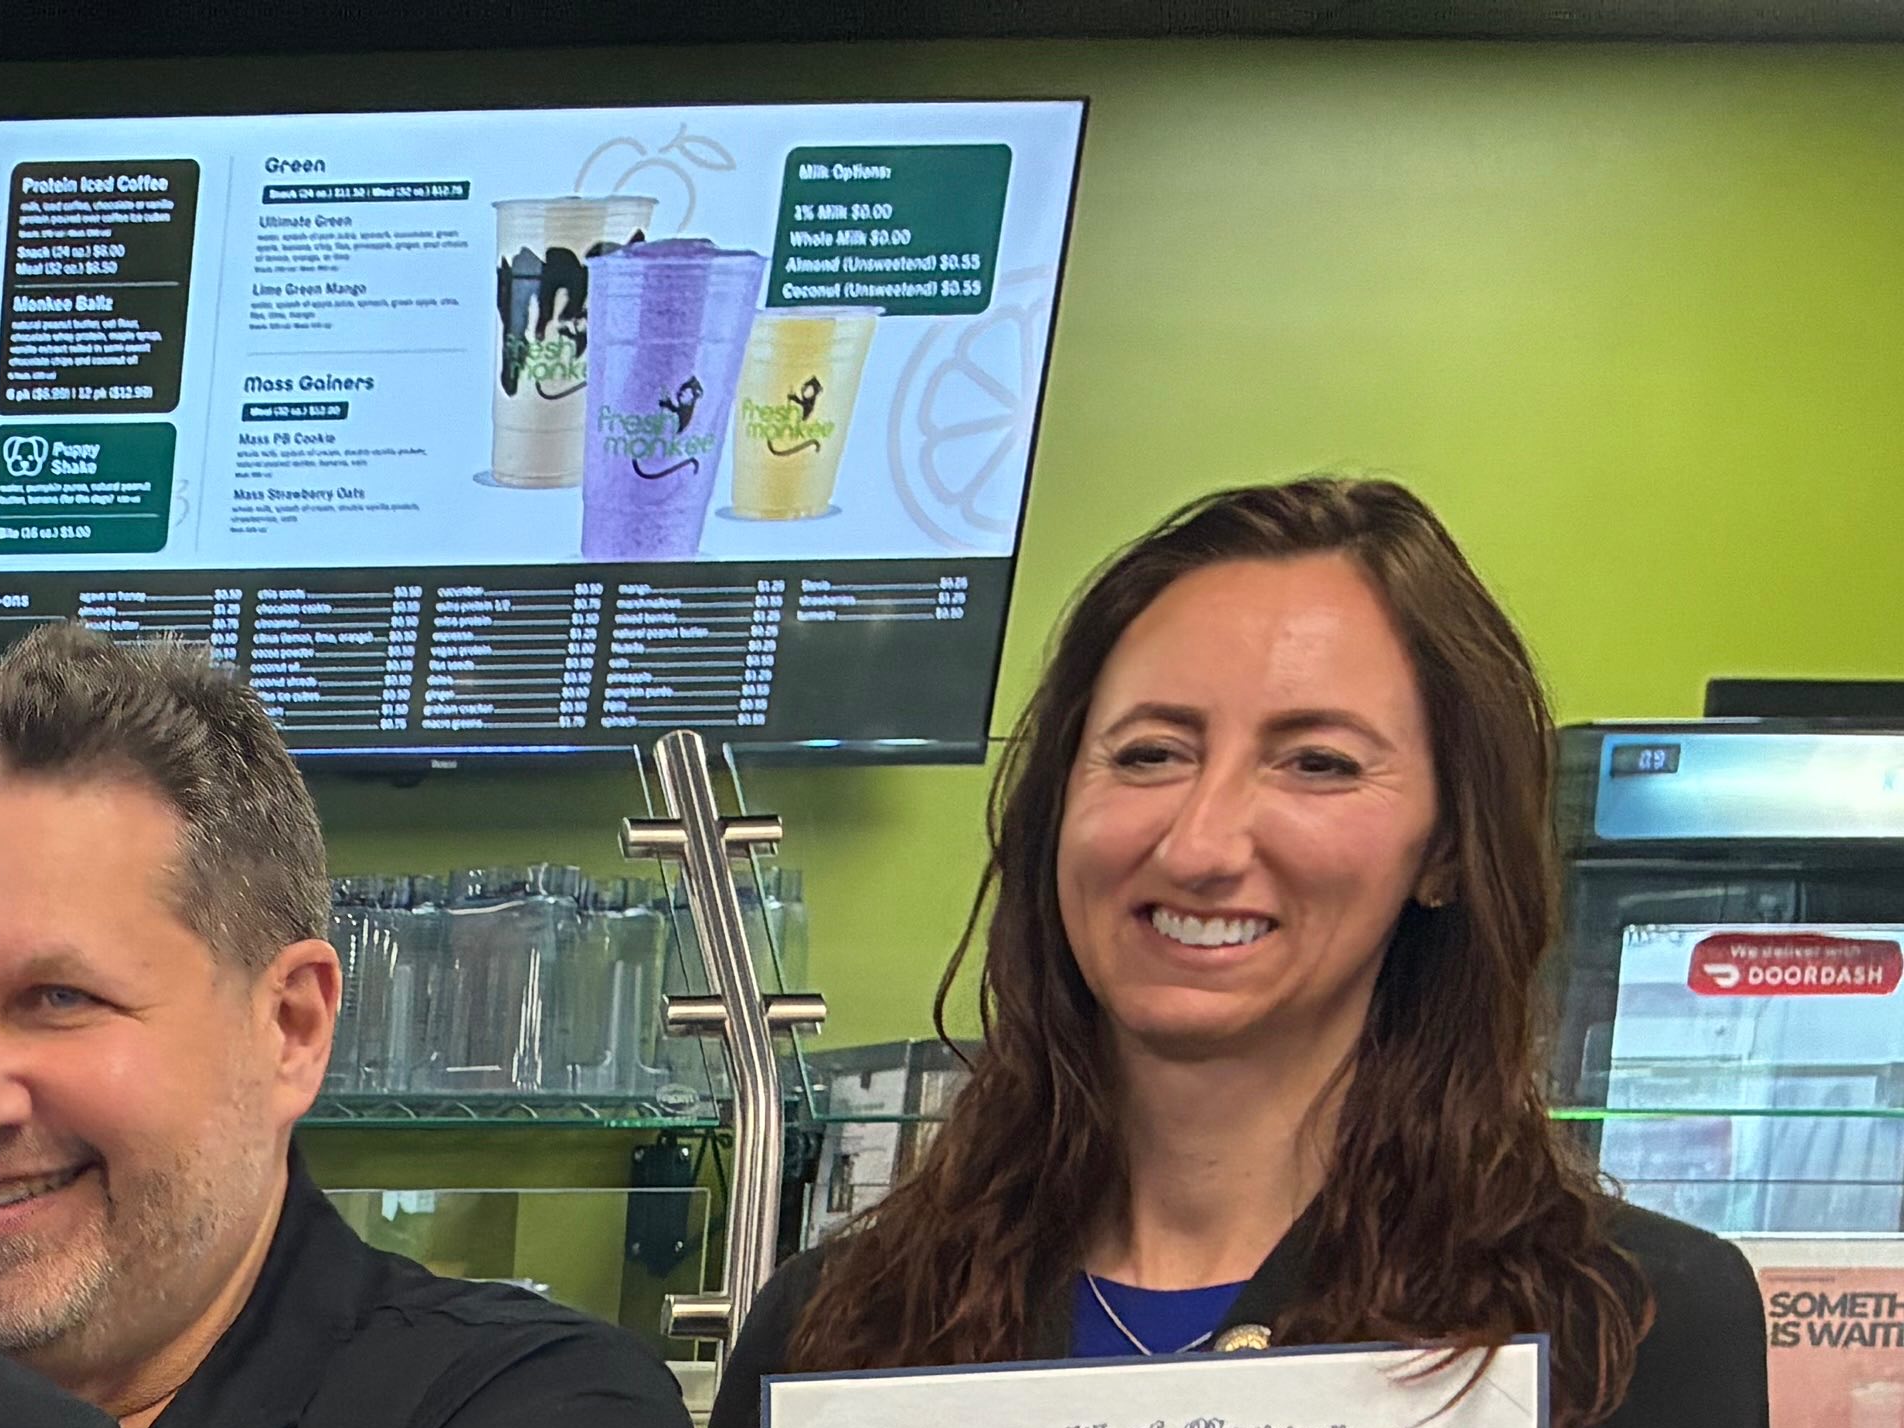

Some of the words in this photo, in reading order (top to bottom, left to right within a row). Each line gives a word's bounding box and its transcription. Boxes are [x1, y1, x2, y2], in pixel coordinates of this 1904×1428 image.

[264, 156, 326, 174] Green
[798, 163, 830, 180] Milk
[831, 163, 892, 182] Options:
[21, 176, 78, 194] Protein
[80, 175, 115, 193] Iced
[116, 174, 169, 193] Coffee
[258, 215, 312, 229] Ultimate
[314, 214, 353, 228] Green
[789, 230, 834, 247] Whole
[835, 229, 867, 246] Milk
[252, 283, 283, 297] Lime
[284, 282, 323, 296] Green
[325, 282, 367, 297] Mango
[243, 375, 294, 393] Mass
[298, 373, 375, 392] Gainers
[597, 408, 680, 436] fresh
[52, 442, 100, 459] Puppy
[51, 460, 97, 475] Shake
[1748, 965, 1883, 986] DOORDASH
[1769, 1291, 1904, 1318] SOMETH
[1771, 1321, 1800, 1347] IS
[1807, 1321, 1904, 1348] WAITI
